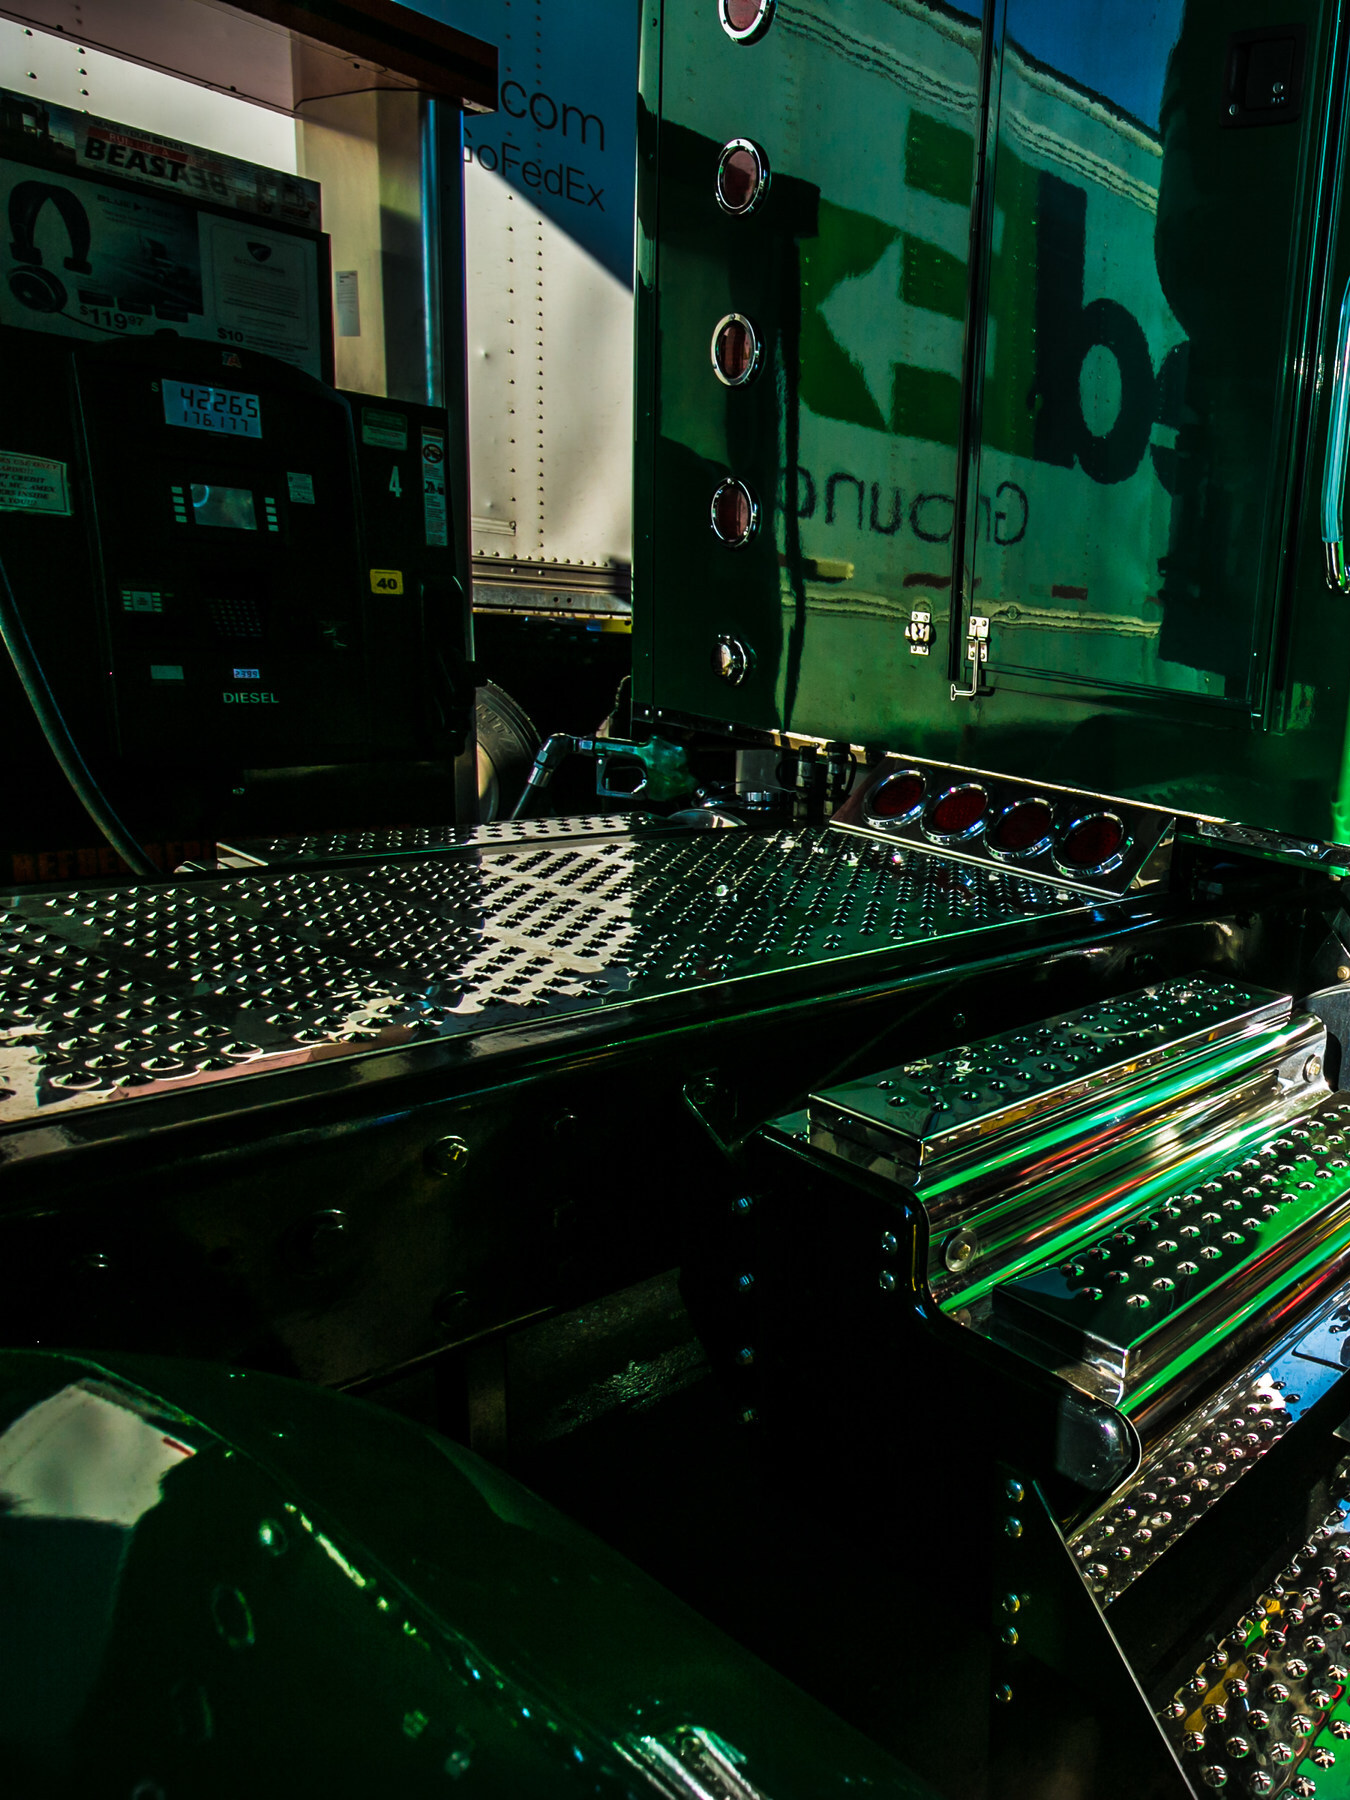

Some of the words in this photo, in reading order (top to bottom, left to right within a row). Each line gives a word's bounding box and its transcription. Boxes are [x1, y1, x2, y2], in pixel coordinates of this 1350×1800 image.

[500, 79, 605, 151] com
[84, 136, 186, 183] BEAST
[388, 465, 403, 498] 4
[375, 577, 398, 590] 40
[222, 691, 280, 704] DIESEL
